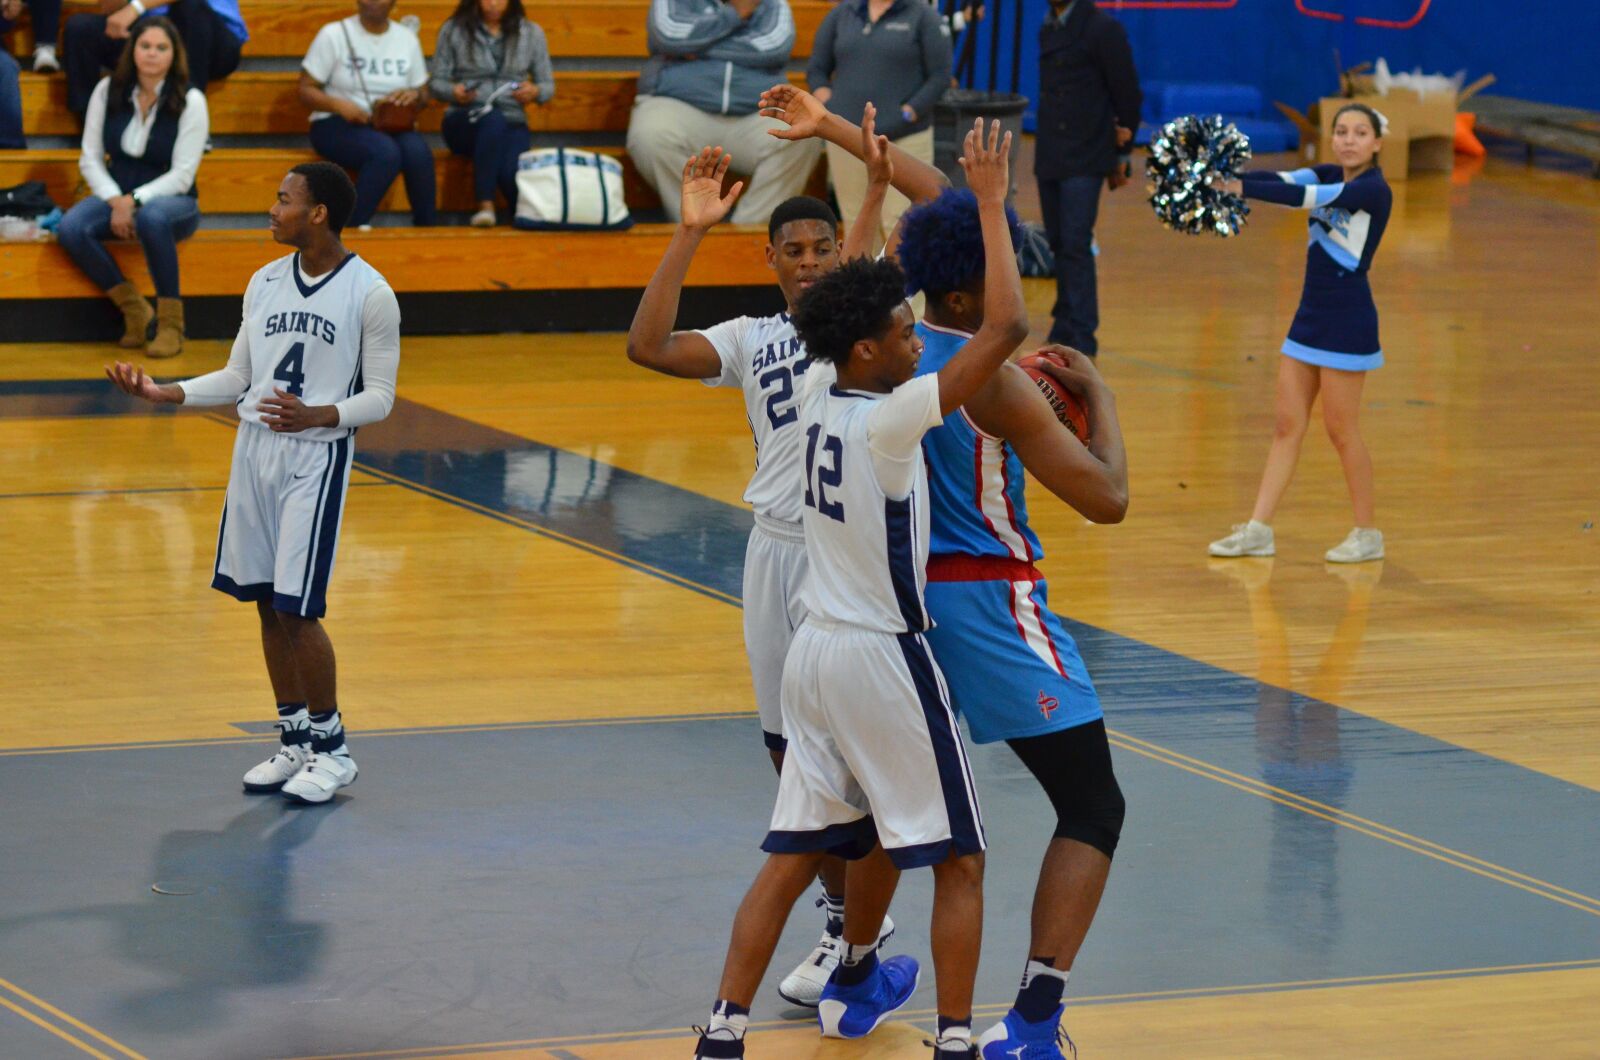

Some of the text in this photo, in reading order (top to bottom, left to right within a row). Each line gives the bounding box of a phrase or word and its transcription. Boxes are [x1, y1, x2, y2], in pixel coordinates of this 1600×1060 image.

[264, 311, 336, 346] SAINTS
[273, 341, 305, 398] 4
[752, 336, 801, 376] SAIN
[805, 422, 845, 523] 12
